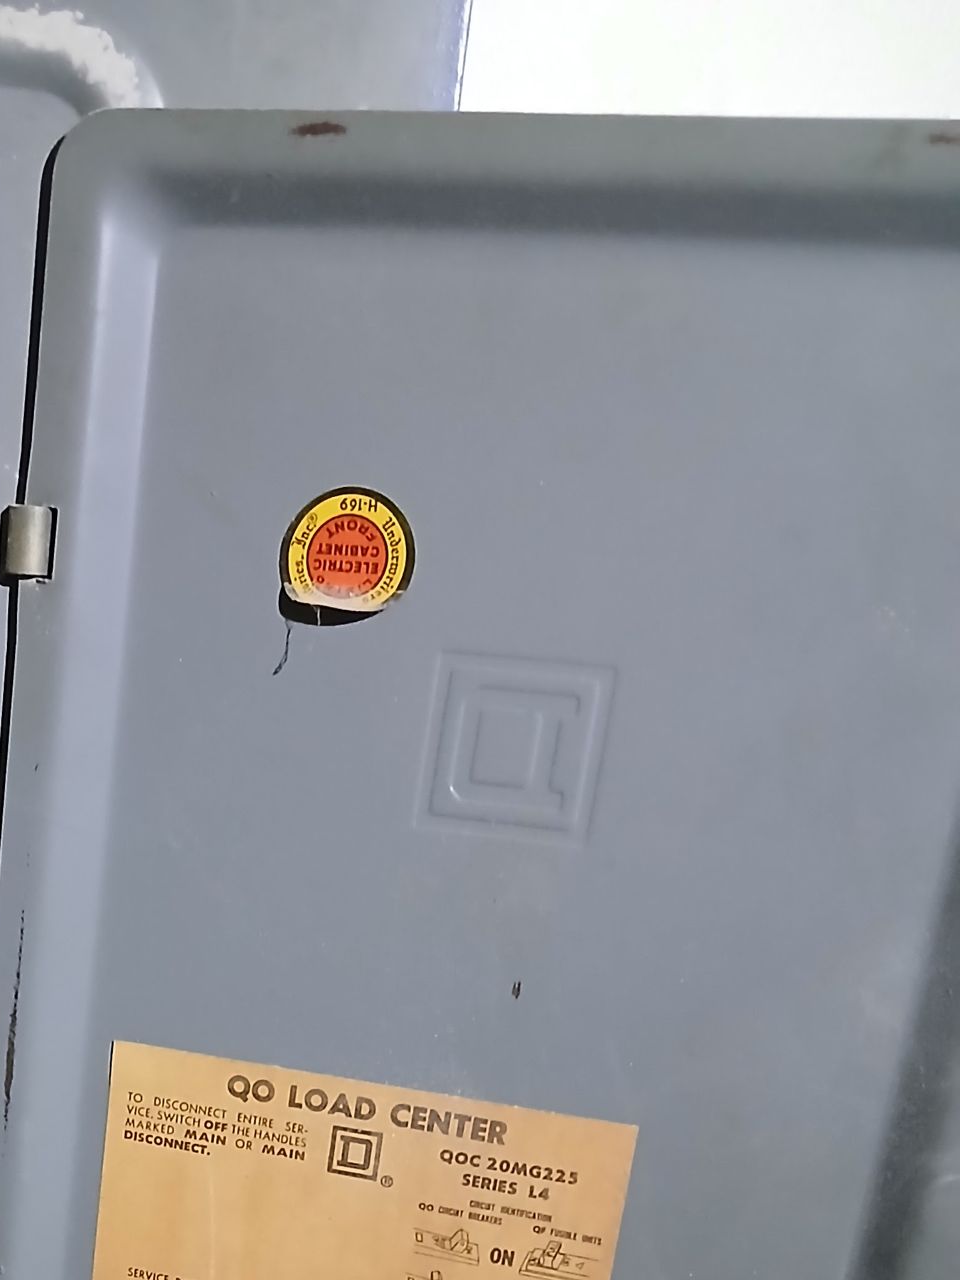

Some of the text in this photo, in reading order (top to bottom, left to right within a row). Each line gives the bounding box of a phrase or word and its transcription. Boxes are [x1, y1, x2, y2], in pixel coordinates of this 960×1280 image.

[326, 519, 376, 542] FRONT
[316, 542, 380, 558] CABINET
[313, 559, 379, 574] ELECTRIC
[128, 1091, 308, 1134] TO DISCONNECT ENTIRE SER-
[227, 1074, 508, 1146] QO LOAD CENTER
[125, 1117, 306, 1160] MARKED MAIN OR MAIN
[157, 1110, 201, 1128] SWITCH
[204, 1120, 228, 1132] OFF
[232, 1124, 250, 1138] THE
[254, 1129, 306, 1148] HANDLES
[124, 1130, 211, 1156] DISCONNECT.
[439, 1149, 579, 1185] QOC 20MG225
[462, 1174, 550, 1200] SERIES L4
[418, 1202, 434, 1212] QO
[490, 1248, 515, 1267] ON
